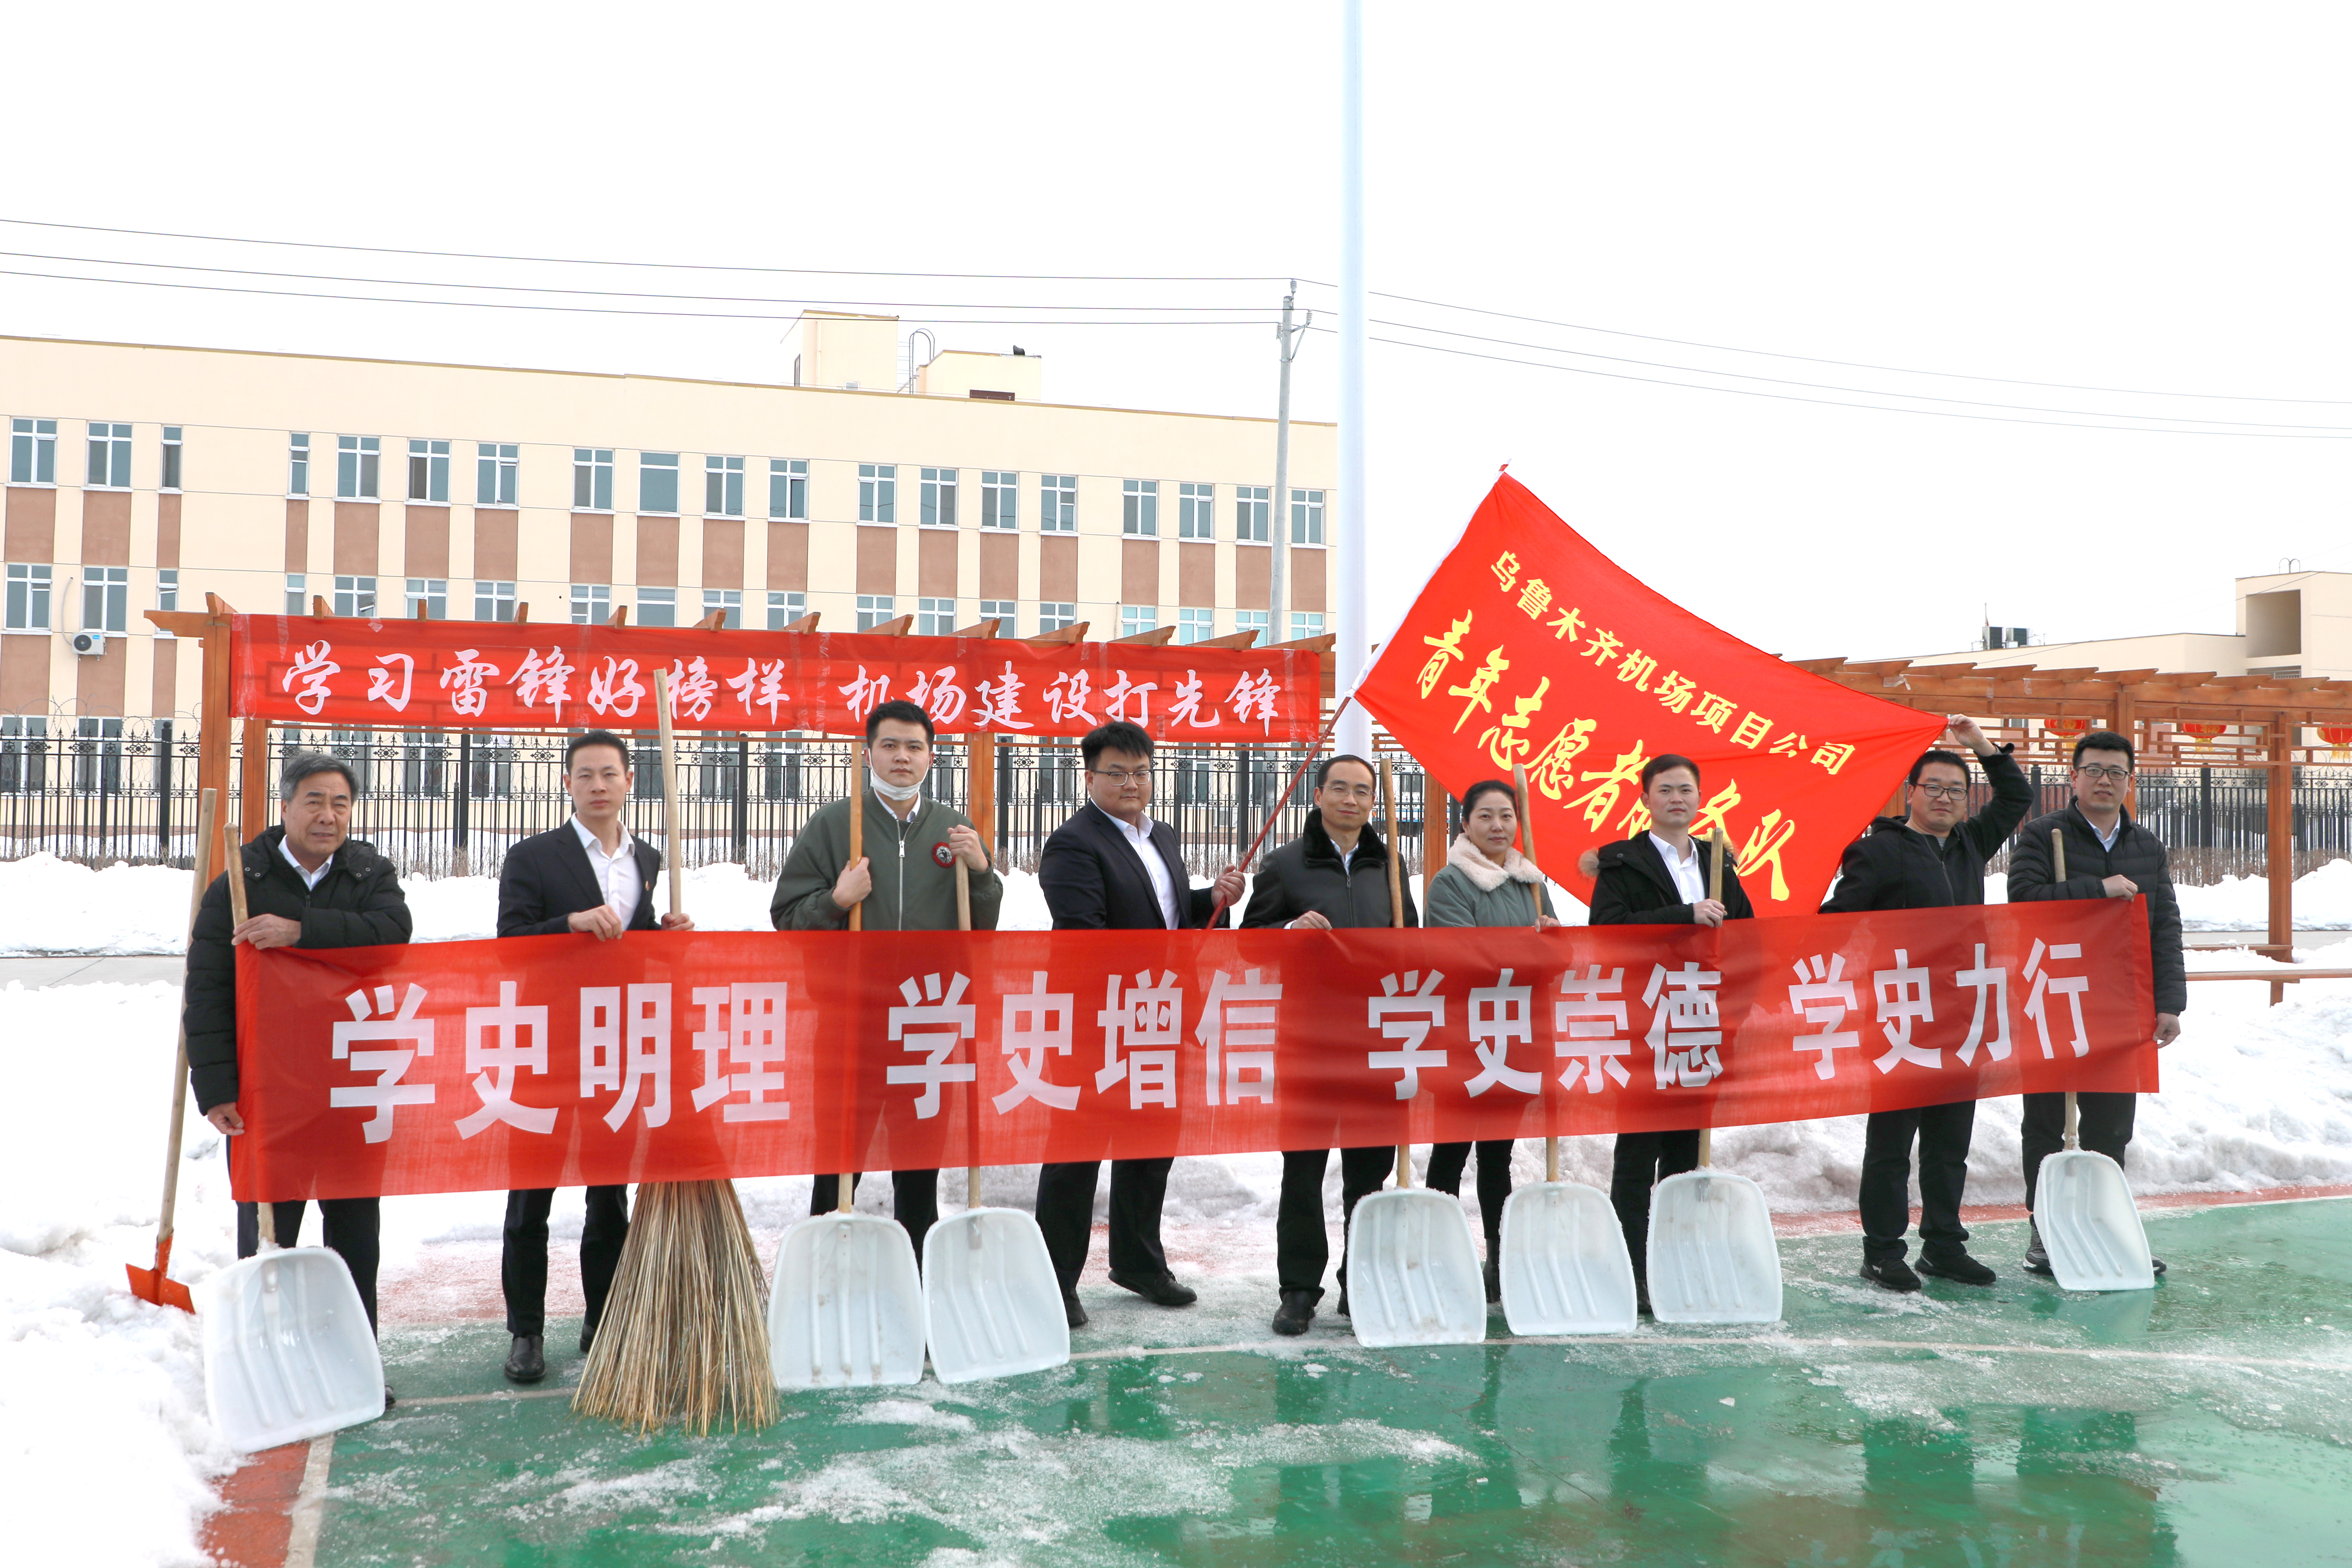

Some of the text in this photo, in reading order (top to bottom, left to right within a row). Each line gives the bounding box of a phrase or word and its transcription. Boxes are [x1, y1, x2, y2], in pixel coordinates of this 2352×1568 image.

[282, 640, 1281, 737] 学习雷锋好榜样 机场建设打先锋
[1490, 551, 1856, 775] 乌鲁木齐机场项目公司
[330, 937, 2090, 1144] 学史明理 学史增信 学史崇德 学史力行
